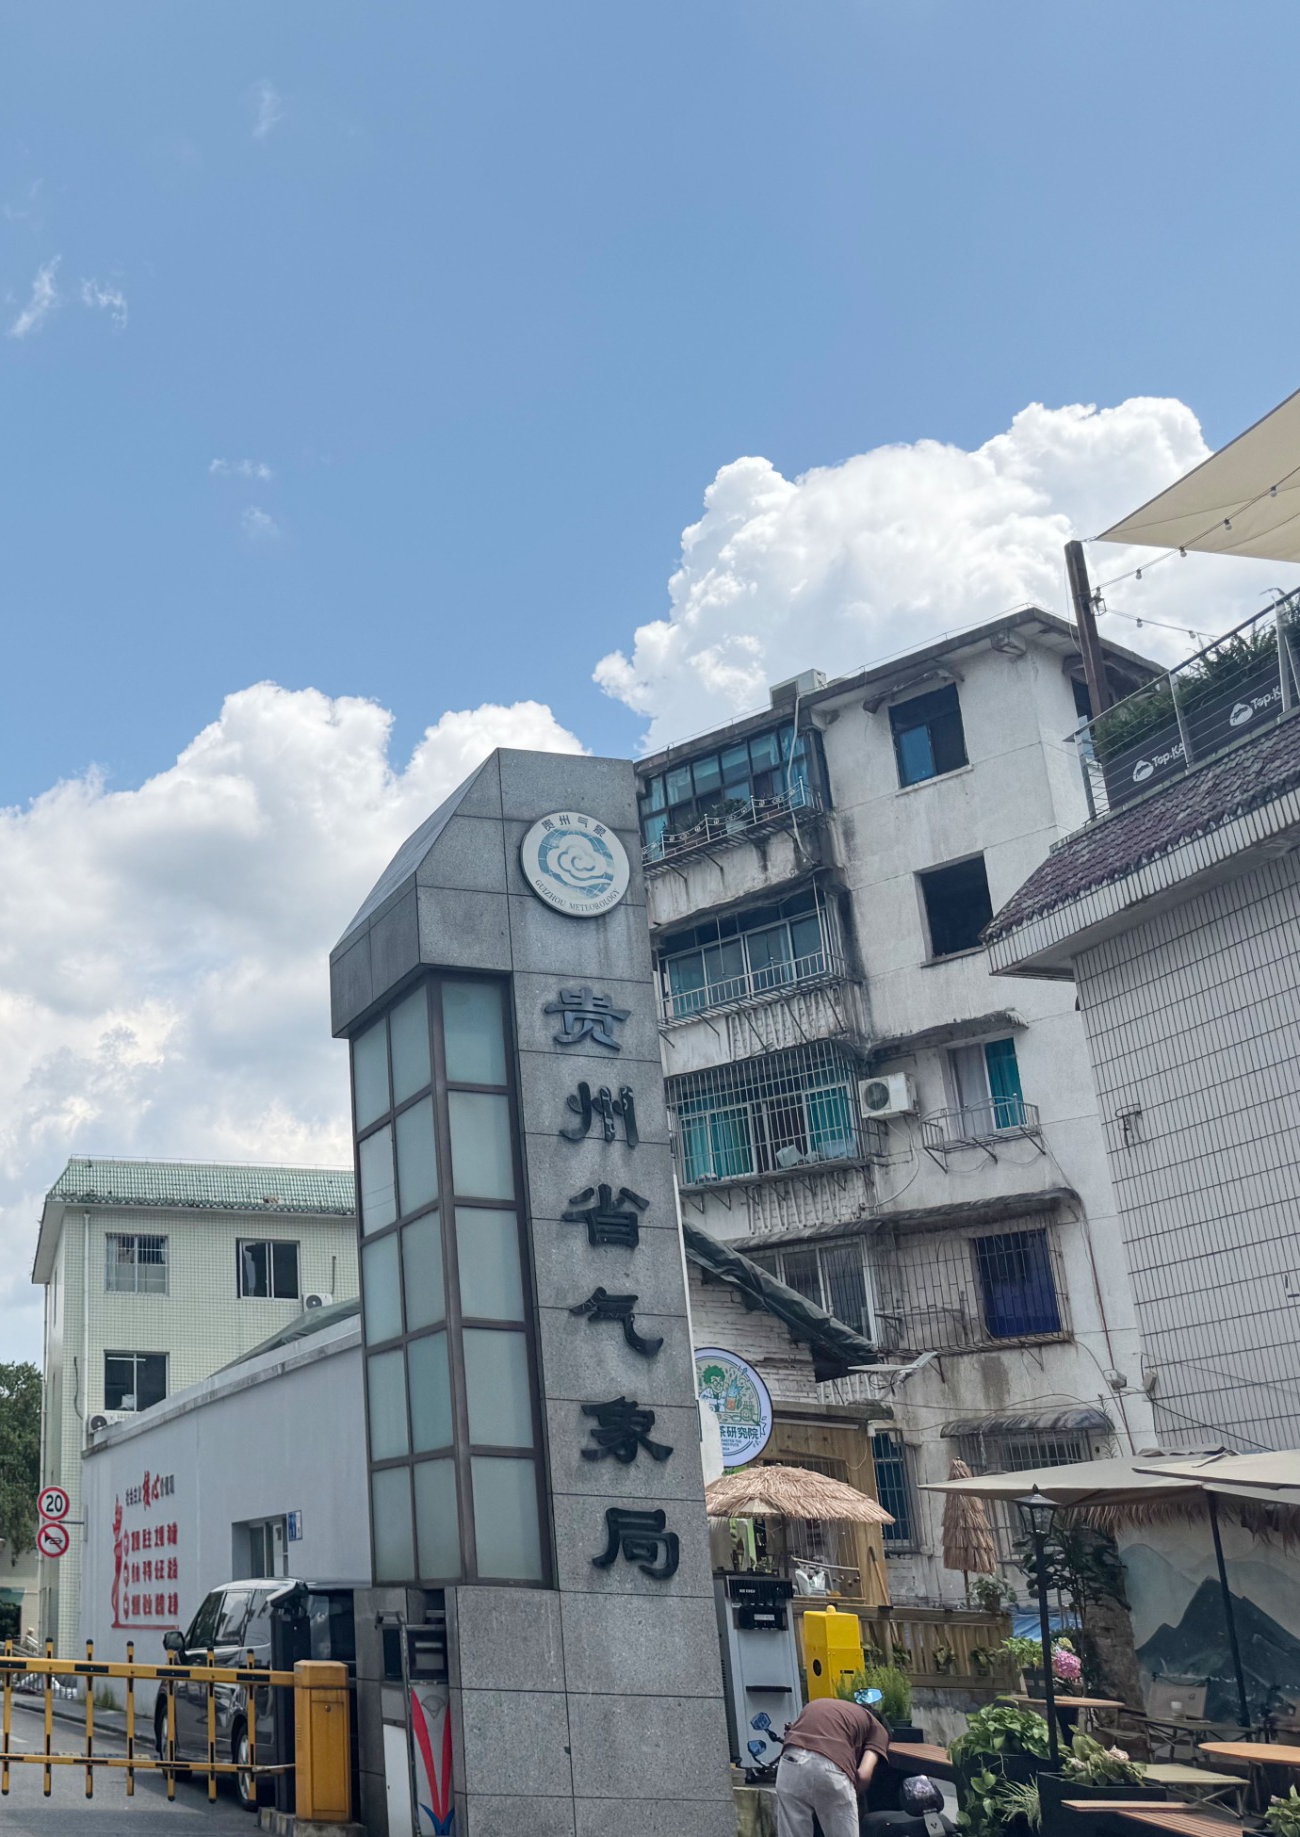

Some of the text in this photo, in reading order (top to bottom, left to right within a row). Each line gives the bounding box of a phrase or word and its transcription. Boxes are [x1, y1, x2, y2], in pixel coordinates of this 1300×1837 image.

[535, 879, 620, 912] GUIZHOU METEOROLOGY
[544, 987, 680, 1580] 贵州省气象局
[46, 1494, 63, 1512] 20
